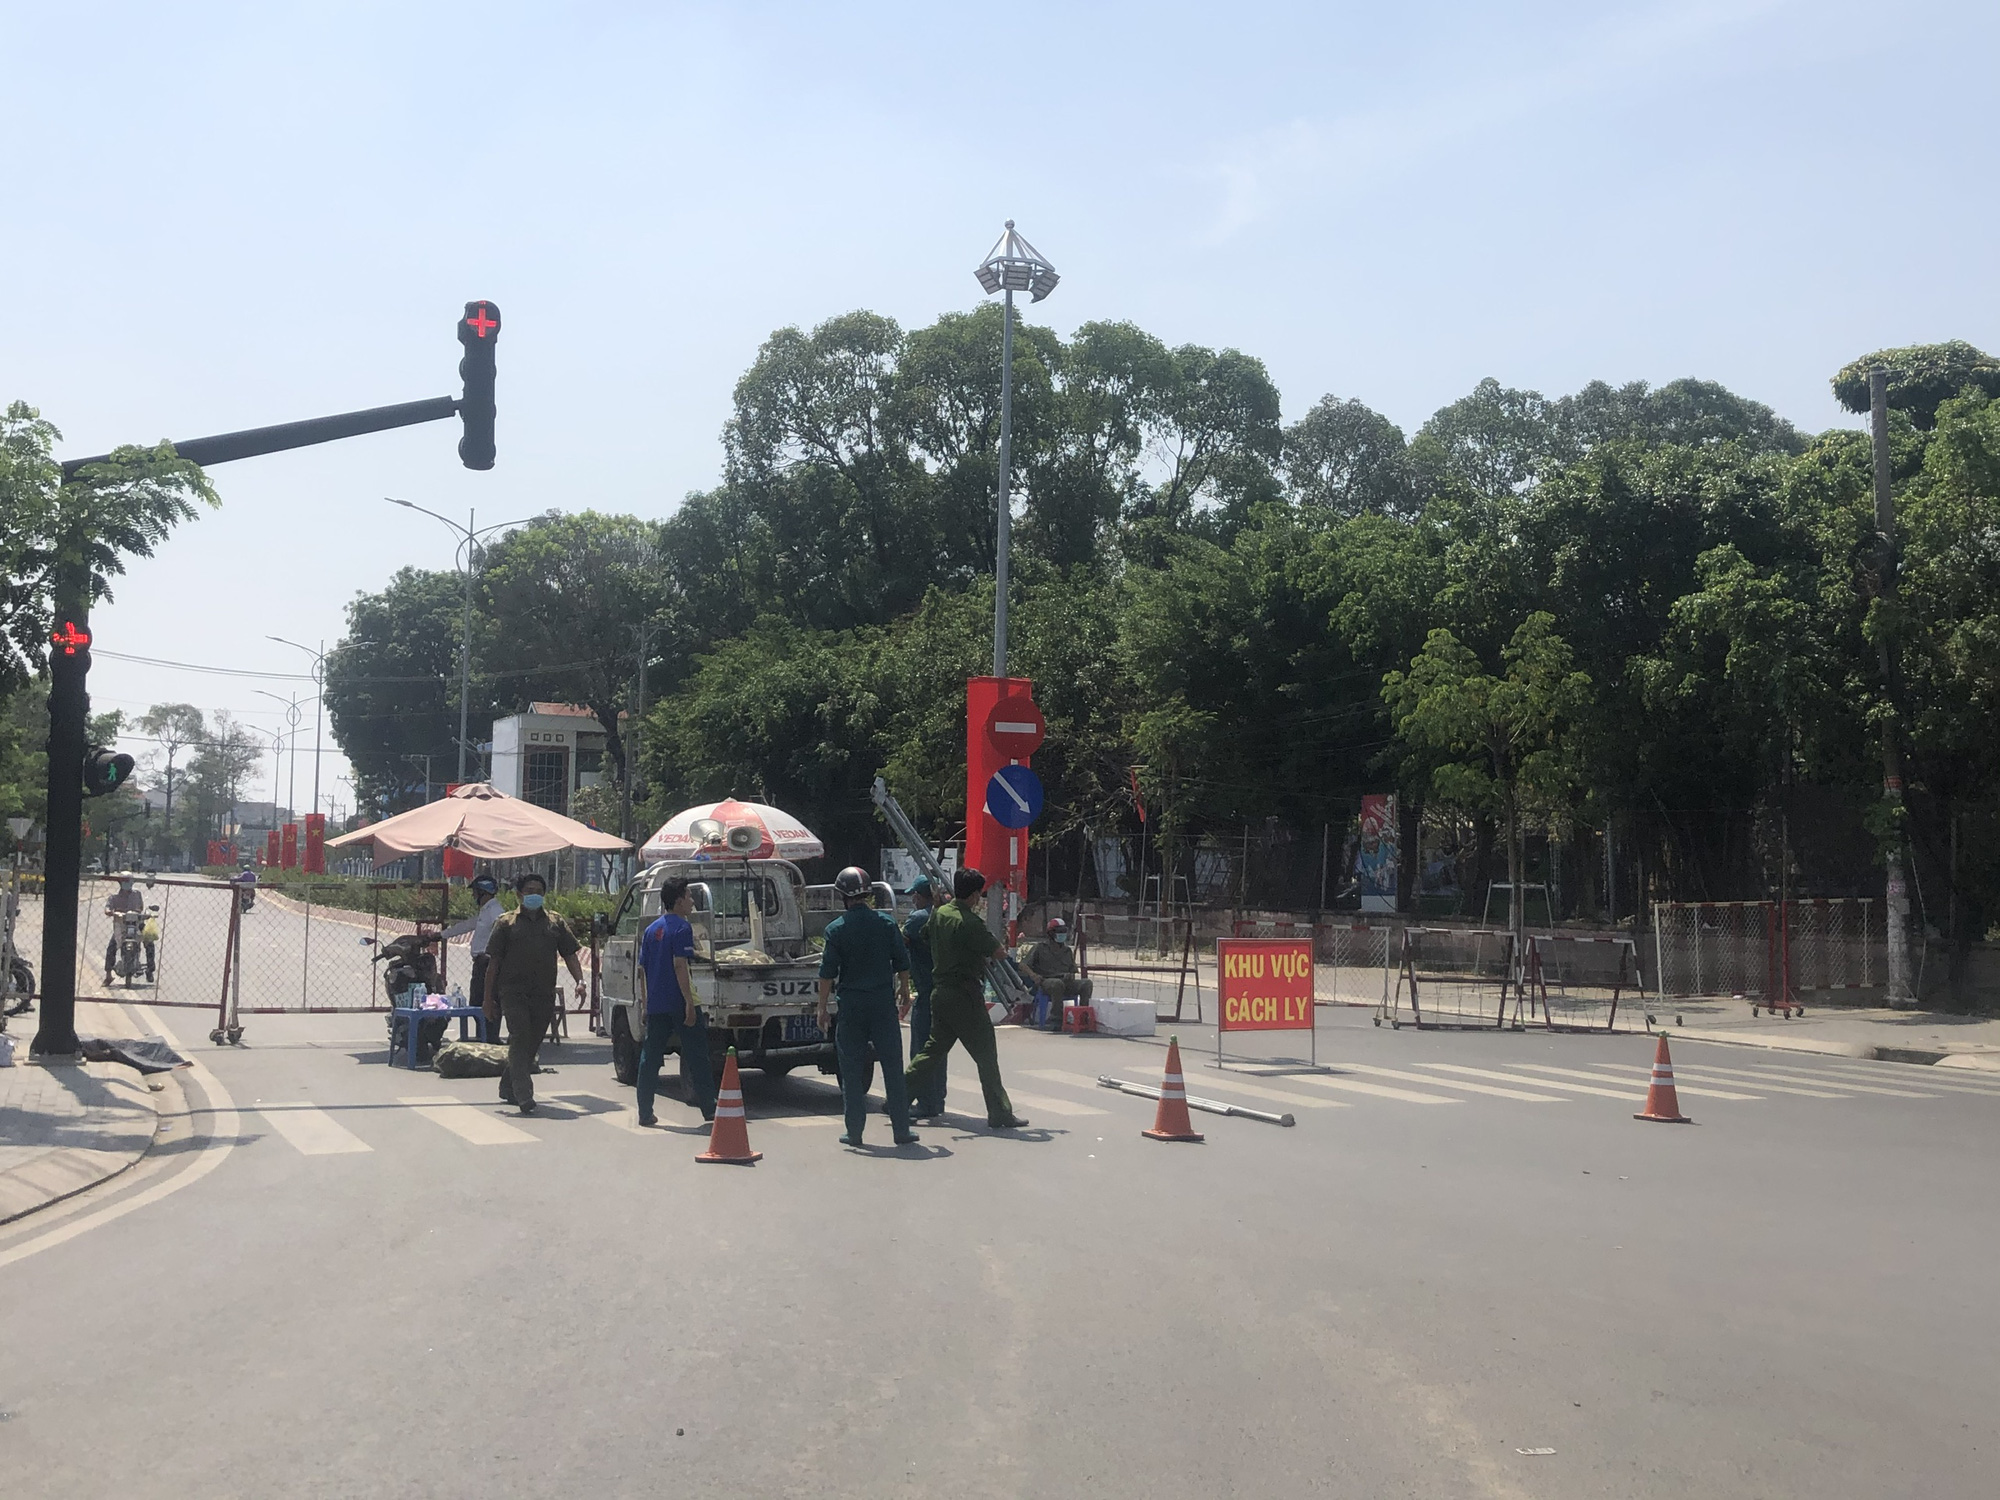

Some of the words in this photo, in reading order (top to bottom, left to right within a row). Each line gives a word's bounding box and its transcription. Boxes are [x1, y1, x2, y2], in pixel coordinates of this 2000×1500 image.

[1224, 954, 1264, 978] KHU
[1270, 949, 1309, 983] VỰC
[763, 981, 836, 996] SUZ
[1225, 991, 1278, 1022] CÁCH
[1284, 996, 1308, 1021] LY
